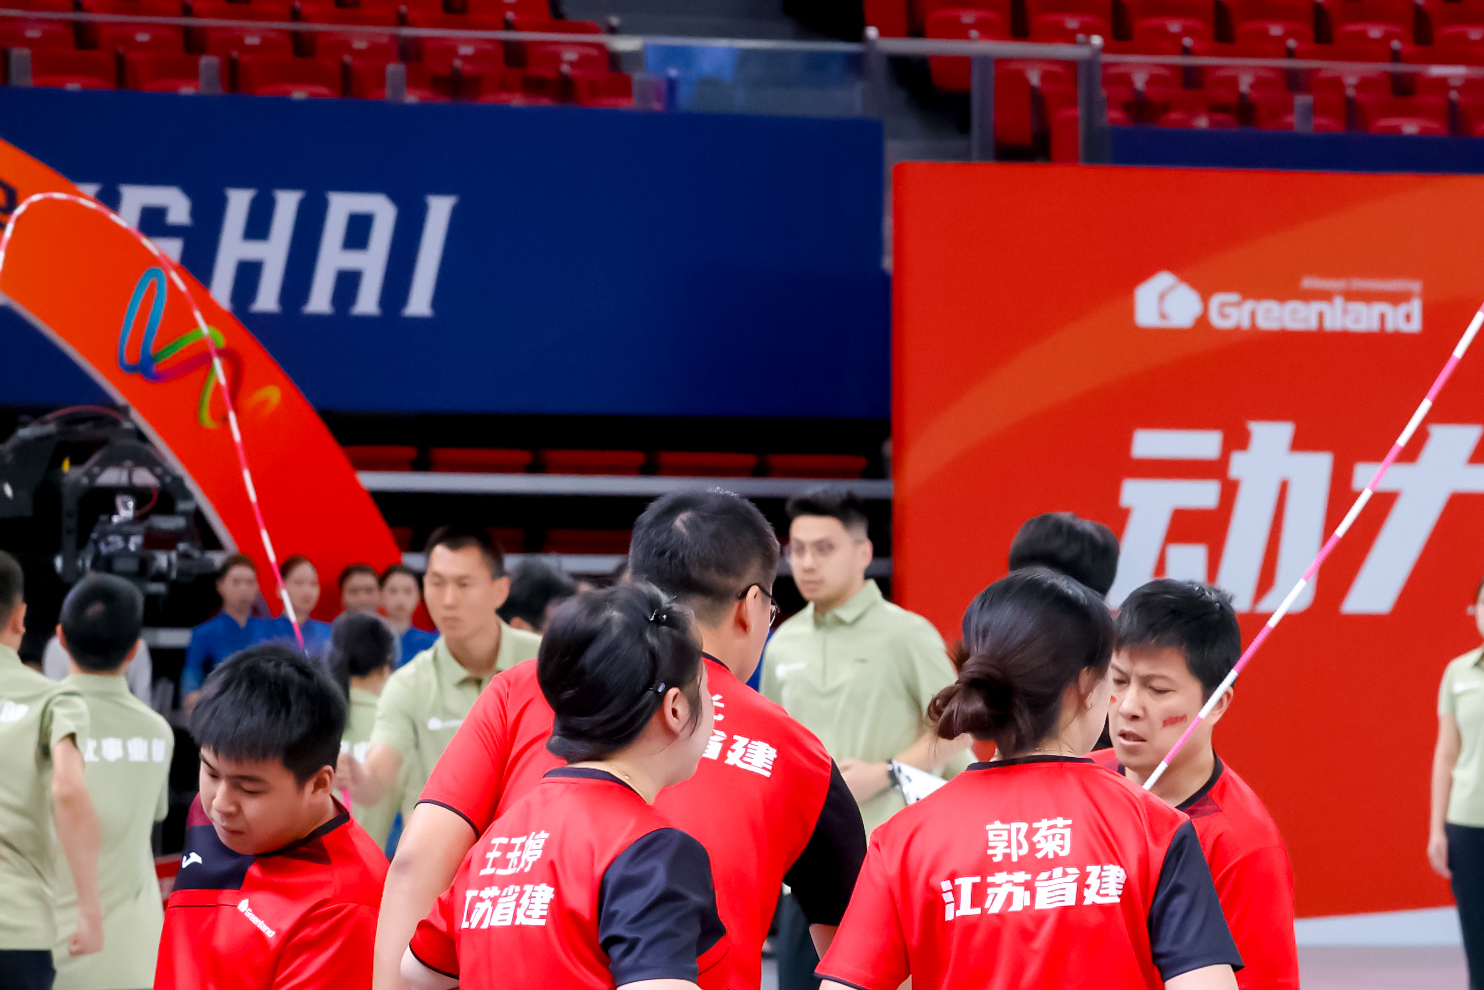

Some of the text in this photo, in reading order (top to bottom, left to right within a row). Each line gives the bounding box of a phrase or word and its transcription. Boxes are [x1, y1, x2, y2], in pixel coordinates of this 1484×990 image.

[76, 183, 460, 318] GHAI
[1207, 291, 1423, 334] Greenland
[985, 816, 1073, 863] 郭菊
[940, 863, 1127, 923] 江苏省建
[244, 908, 276, 939] Greenland
